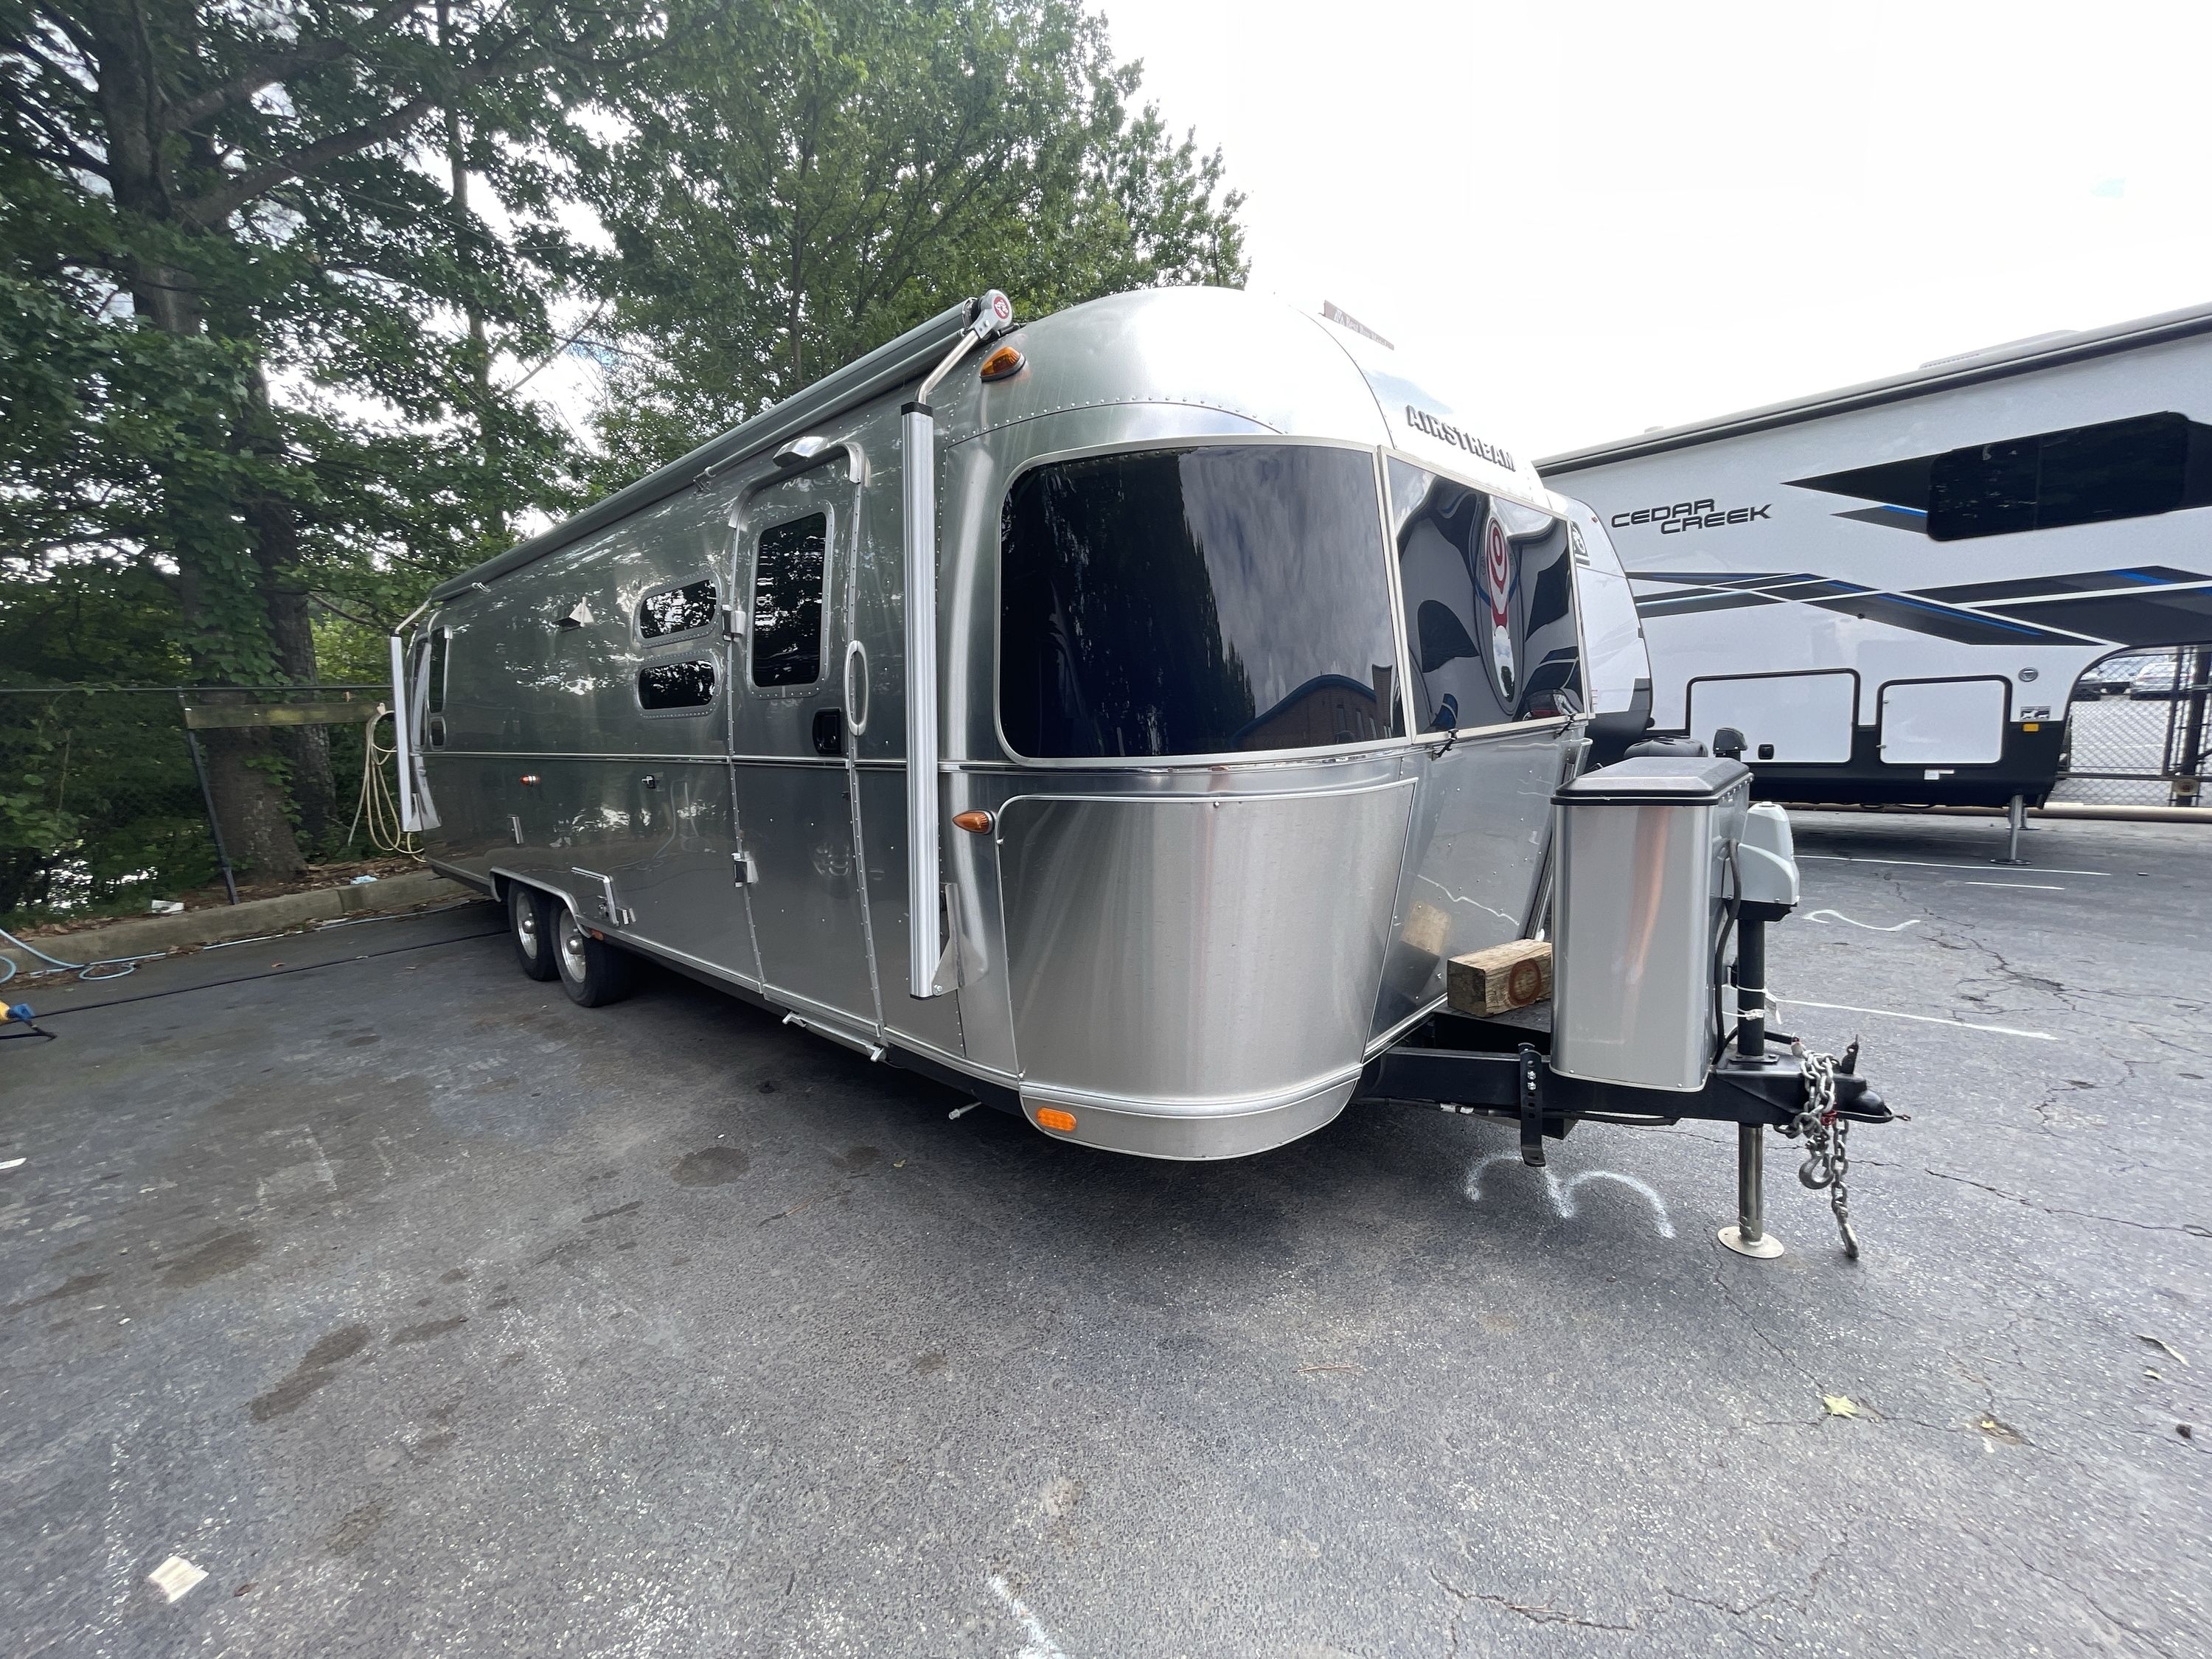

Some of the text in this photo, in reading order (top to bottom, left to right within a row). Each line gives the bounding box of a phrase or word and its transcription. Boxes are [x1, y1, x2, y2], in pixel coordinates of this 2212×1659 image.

[1405, 405, 1516, 472] AIRSTREAM
[1611, 498, 1715, 528] CEDAR
[1660, 504, 1772, 535] CREEK
